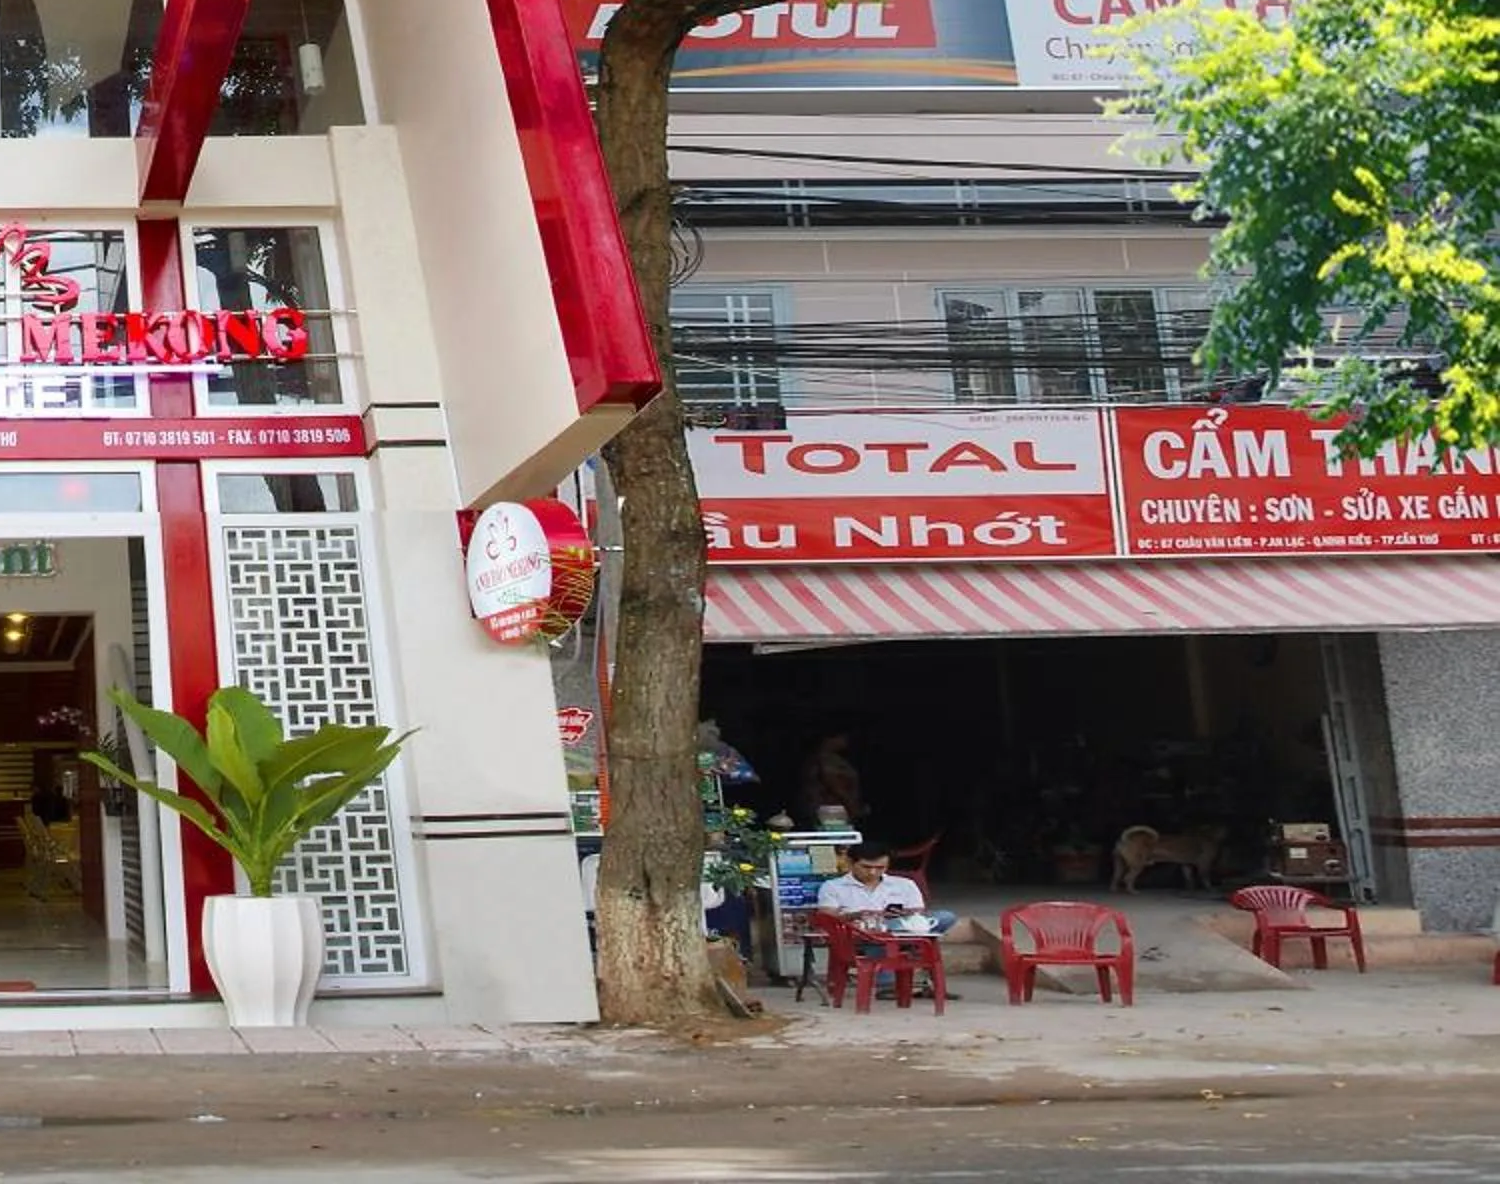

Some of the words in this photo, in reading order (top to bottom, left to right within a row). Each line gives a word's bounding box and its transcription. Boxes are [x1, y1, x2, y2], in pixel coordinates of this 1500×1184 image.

[20, 308, 308, 364] MEKONG
[125, 430, 157, 446] 0710
[159, 430, 191, 446] 3819
[259, 428, 290, 445] 0710
[292, 428, 324, 444] 3819
[714, 435, 1077, 474] TOTAL
[1140, 493, 1242, 524] CHUYÊN
[1397, 495, 1432, 520] XE
[833, 510, 1069, 548] Nhớt
